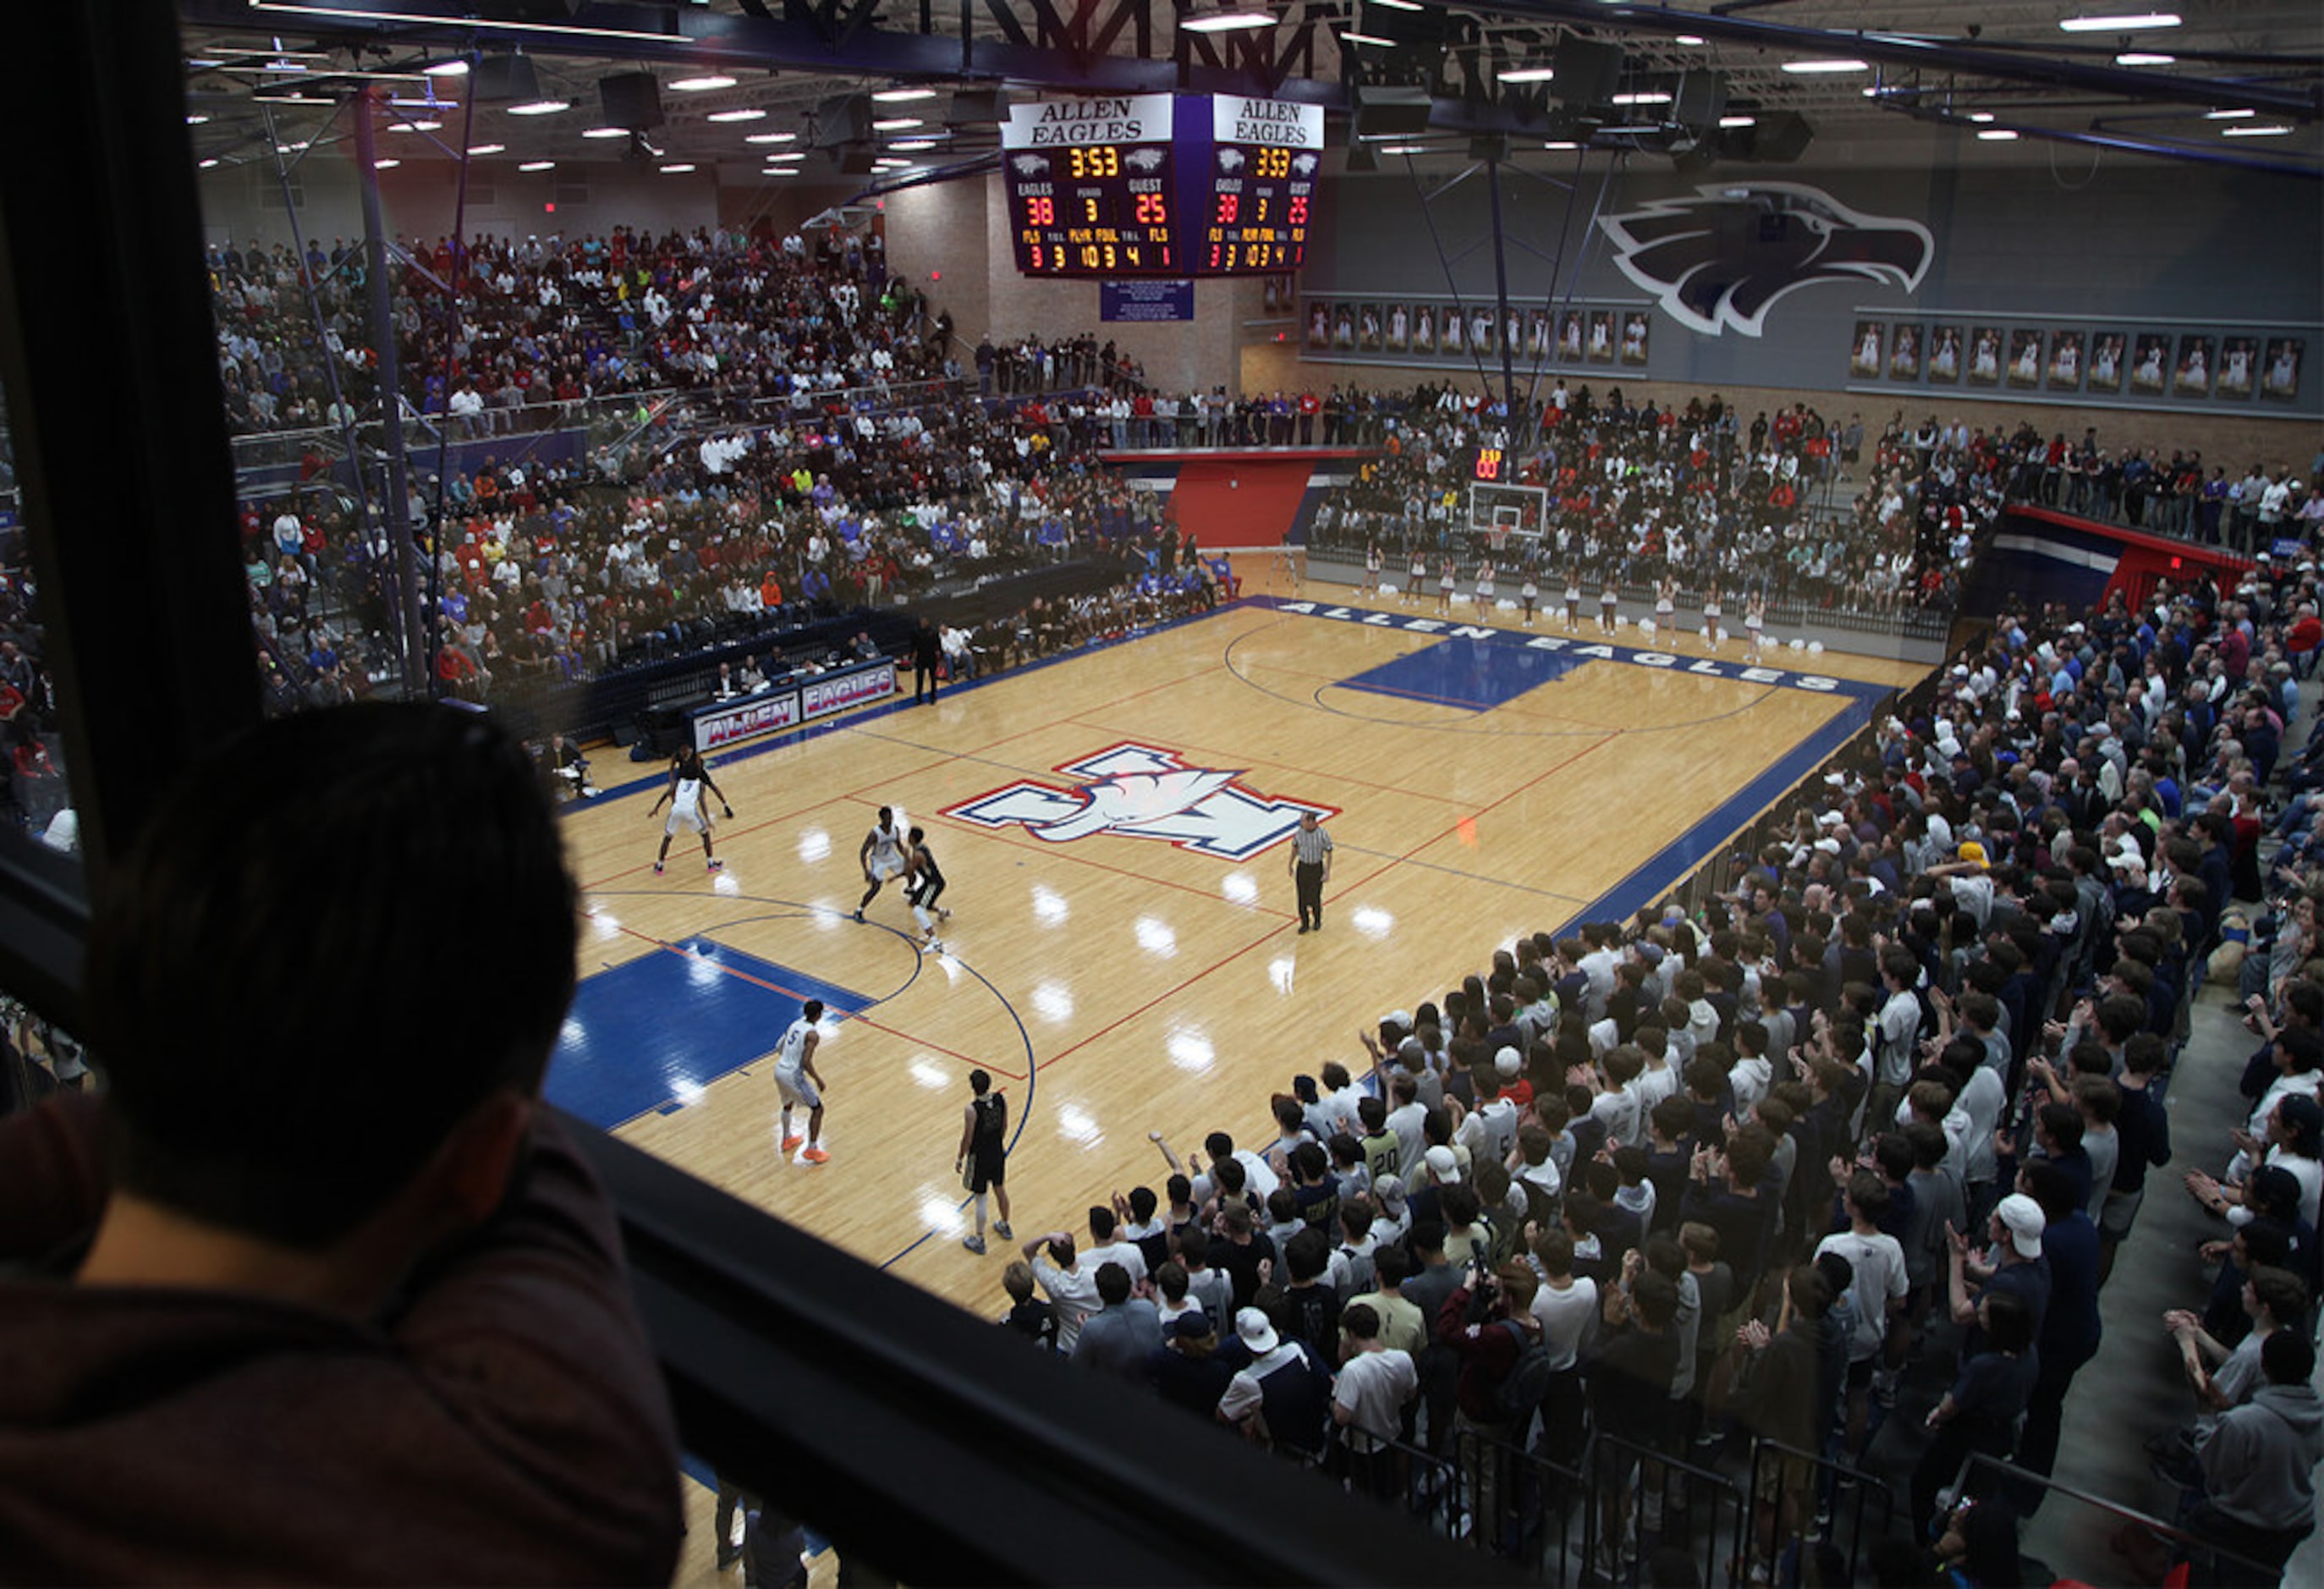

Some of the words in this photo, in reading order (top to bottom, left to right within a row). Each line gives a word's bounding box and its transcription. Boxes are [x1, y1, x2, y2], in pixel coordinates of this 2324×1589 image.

[1040, 99, 1132, 123] ALLEN
[1241, 100, 1300, 123] ALLEN
[1030, 120, 1141, 145] EAGLES
[1235, 121, 1307, 144] EAGLES
[1069, 146, 1118, 179] 3:53
[1128, 178, 1162, 193] GUEST
[1027, 196, 1054, 227] 38
[1085, 197, 1098, 223] 3
[1136, 193, 1167, 224] 25
[1149, 227, 1168, 243] FLS
[1031, 245, 1043, 268] 3
[1054, 244, 1066, 269] 3
[1104, 244, 1117, 269] 3
[1126, 245, 1140, 267] 4
[1162, 245, 1170, 267] 1
[1476, 458, 1497, 480] 00
[1277, 602, 1497, 641] ALLEN
[1525, 636, 1839, 691] EAGLES
[806, 669, 891, 713] EAGLES
[708, 700, 790, 745] ALLEN
[1374, 1147, 1398, 1177] 20
